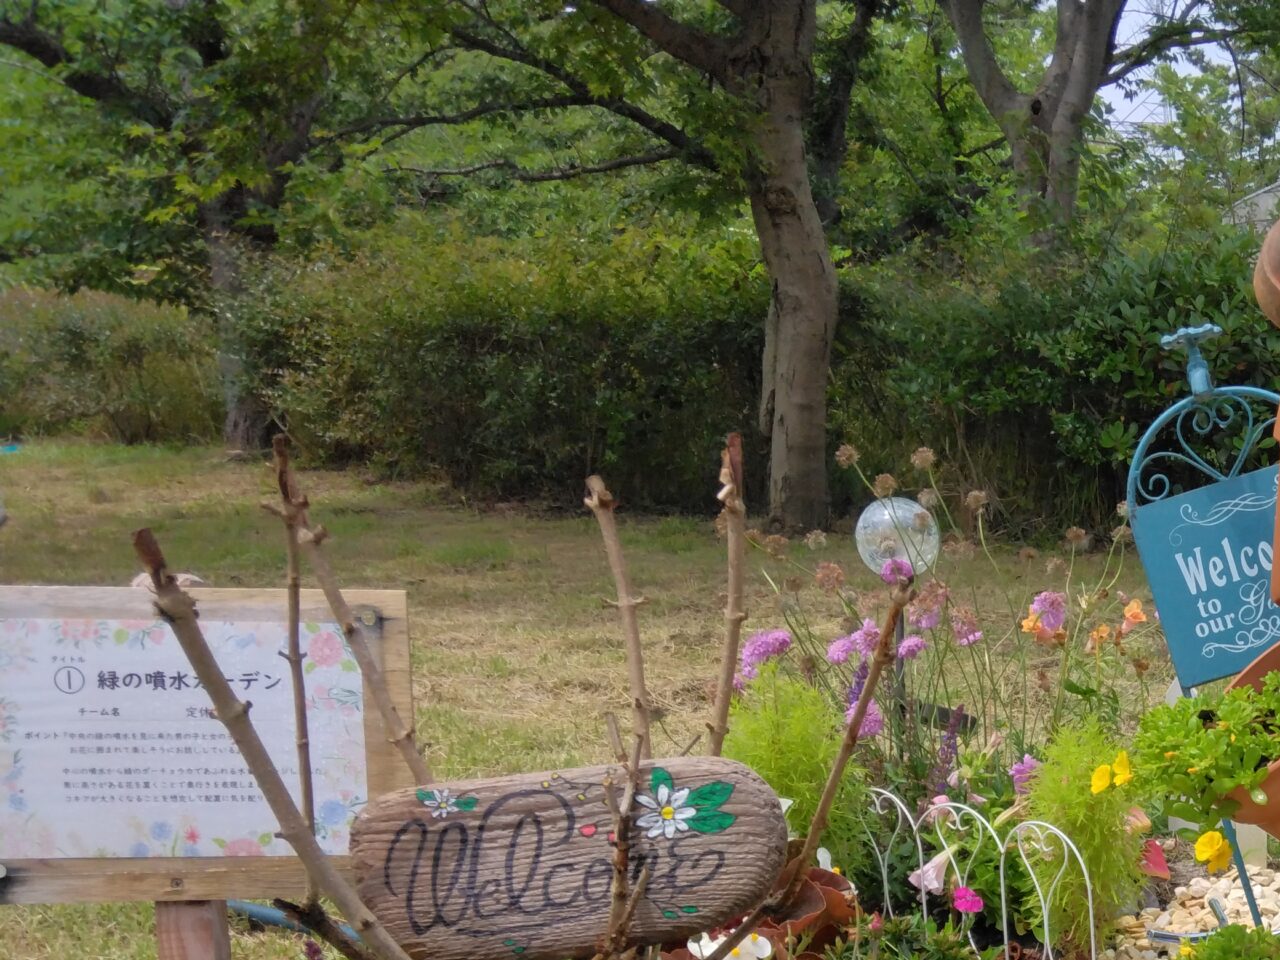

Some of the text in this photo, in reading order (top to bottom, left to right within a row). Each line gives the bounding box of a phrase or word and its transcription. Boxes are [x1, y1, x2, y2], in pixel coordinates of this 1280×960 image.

[1174, 536, 1274, 595] Welco
[1197, 597, 1222, 618] to
[1195, 612, 1235, 638] our
[51, 655, 86, 664] タイトル
[78, 707, 121, 718] チーム名
[24, 731, 59, 741] ポイント
